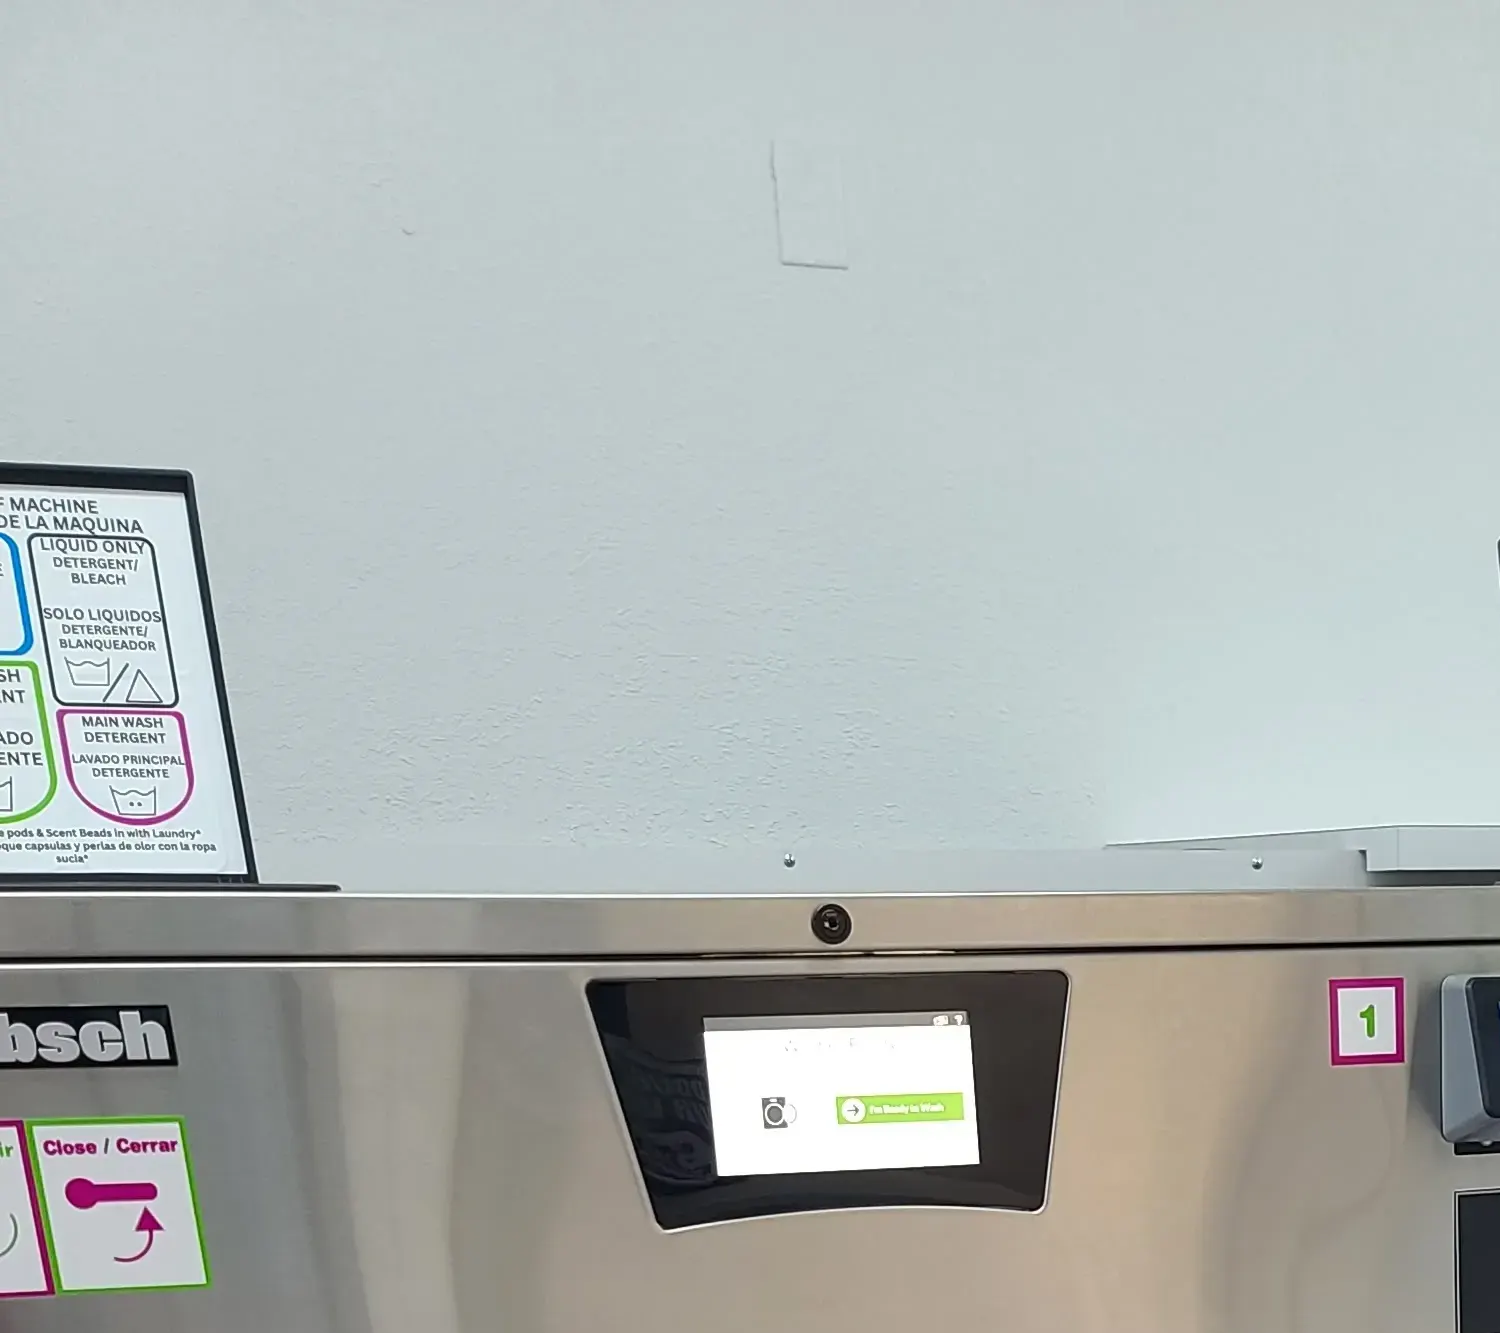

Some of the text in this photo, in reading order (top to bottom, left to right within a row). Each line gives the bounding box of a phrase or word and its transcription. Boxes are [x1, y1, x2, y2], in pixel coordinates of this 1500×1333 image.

[9, 497, 99, 514] MACHINE
[25, 515, 49, 530] LA
[53, 516, 144, 535] MAQUINA
[40, 538, 145, 554] LIQUID ONLY
[53, 557, 138, 571] DETERGENT/
[71, 573, 126, 585] BLEACH
[43, 608, 161, 624] SOLO LIQUIDOS
[61, 624, 148, 638] DETERGENTE/
[59, 638, 156, 652] BLANQUEADOR
[81, 716, 163, 729] MAIN WASH
[84, 732, 165, 744] DETERGENT
[72, 754, 184, 766] LAVADO PRINCIPAL
[92, 767, 169, 779] DETERGENTE
[7, 828, 34, 840] pods
[36, 829, 44, 839] &
[46, 829, 77, 839] Scent
[79, 829, 111, 838] Beads
[113, 829, 124, 838] in
[126, 829, 150, 838] with
[25, 841, 71, 853] capsulas
[83, 842, 115, 853] perlas
[119, 841, 132, 851] de
[134, 841, 155, 851] olor
[158, 844, 177, 852] con
[179, 842, 190, 852] la
[192, 844, 216, 854] ropa
[1359, 1003, 1376, 1039] 1
[0, 1010, 170, 1063] bsch
[43, 1139, 97, 1156] Close
[116, 1138, 178, 1154] Cerrar
